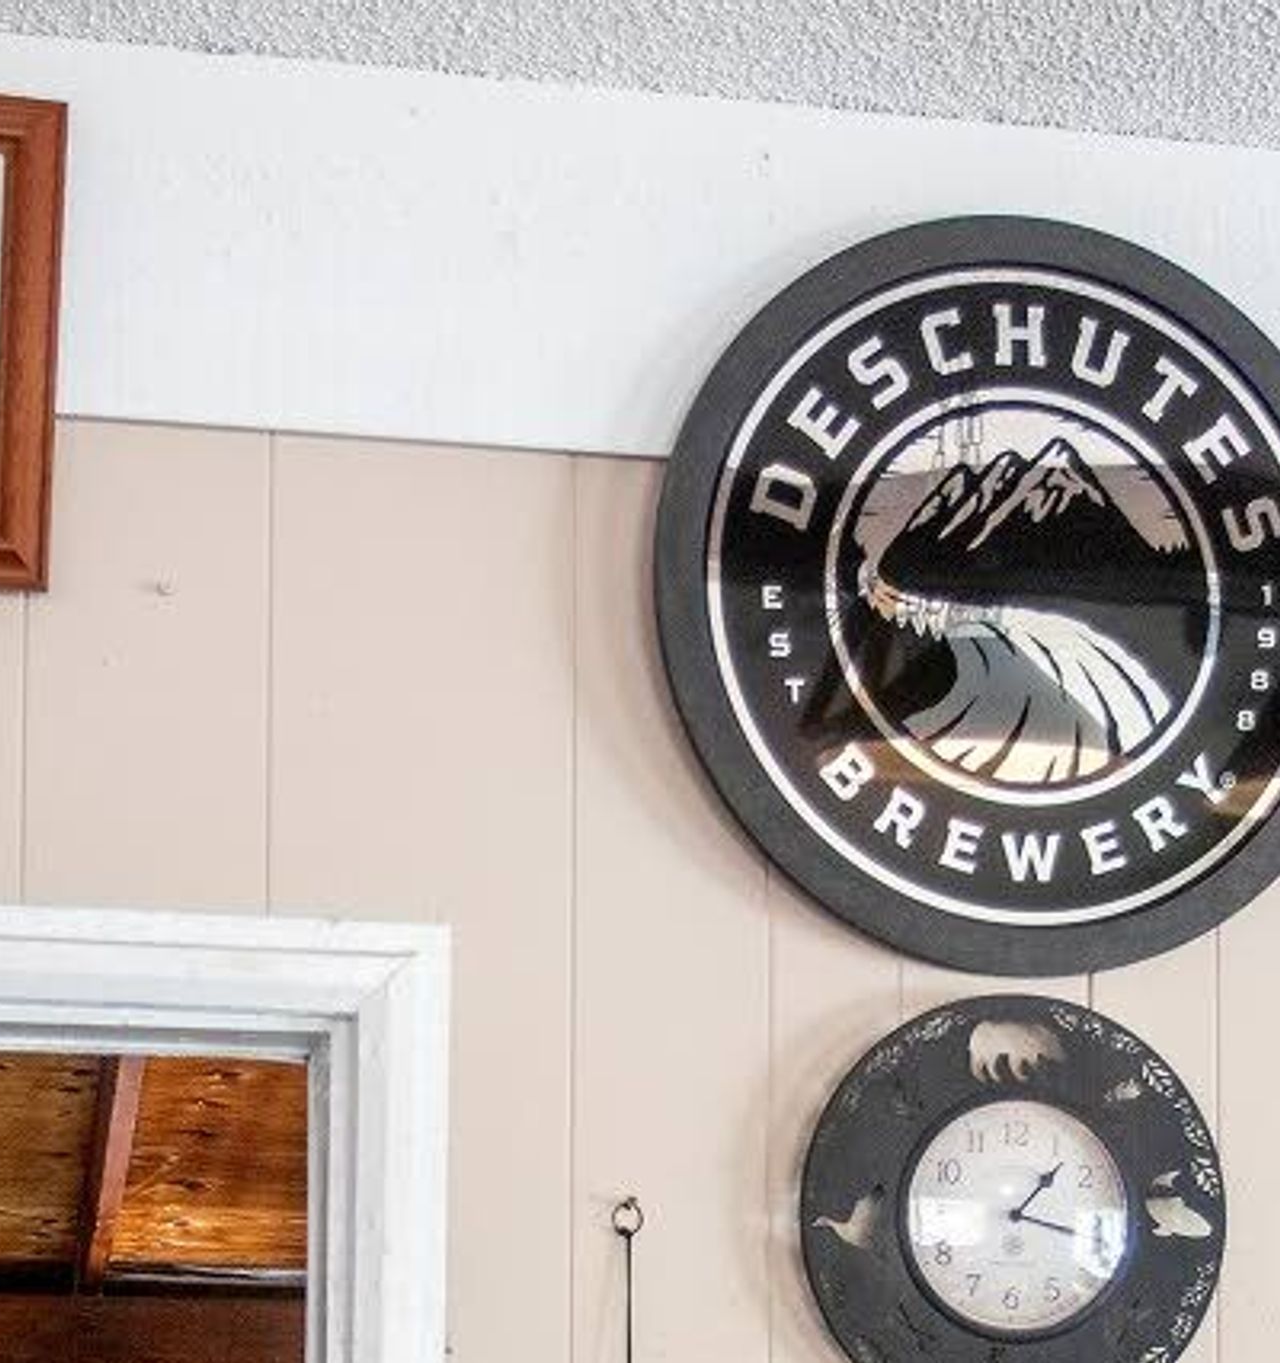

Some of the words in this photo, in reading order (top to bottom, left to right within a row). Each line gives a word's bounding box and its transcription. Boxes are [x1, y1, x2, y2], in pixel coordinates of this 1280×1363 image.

[761, 584, 806, 703] EST
[1236, 584, 1277, 730] 1988
[821, 751, 1231, 882] BREWERY
[967, 1130, 984, 1153] 11
[1001, 1122, 1029, 1147] 12
[937, 1159, 961, 1185] 10
[1078, 1165, 1093, 1188] 2
[935, 1240, 952, 1266] 8
[966, 1272, 981, 1297] 7
[1044, 1276, 1061, 1301] 5
[1002, 1285, 1020, 1310] 6
